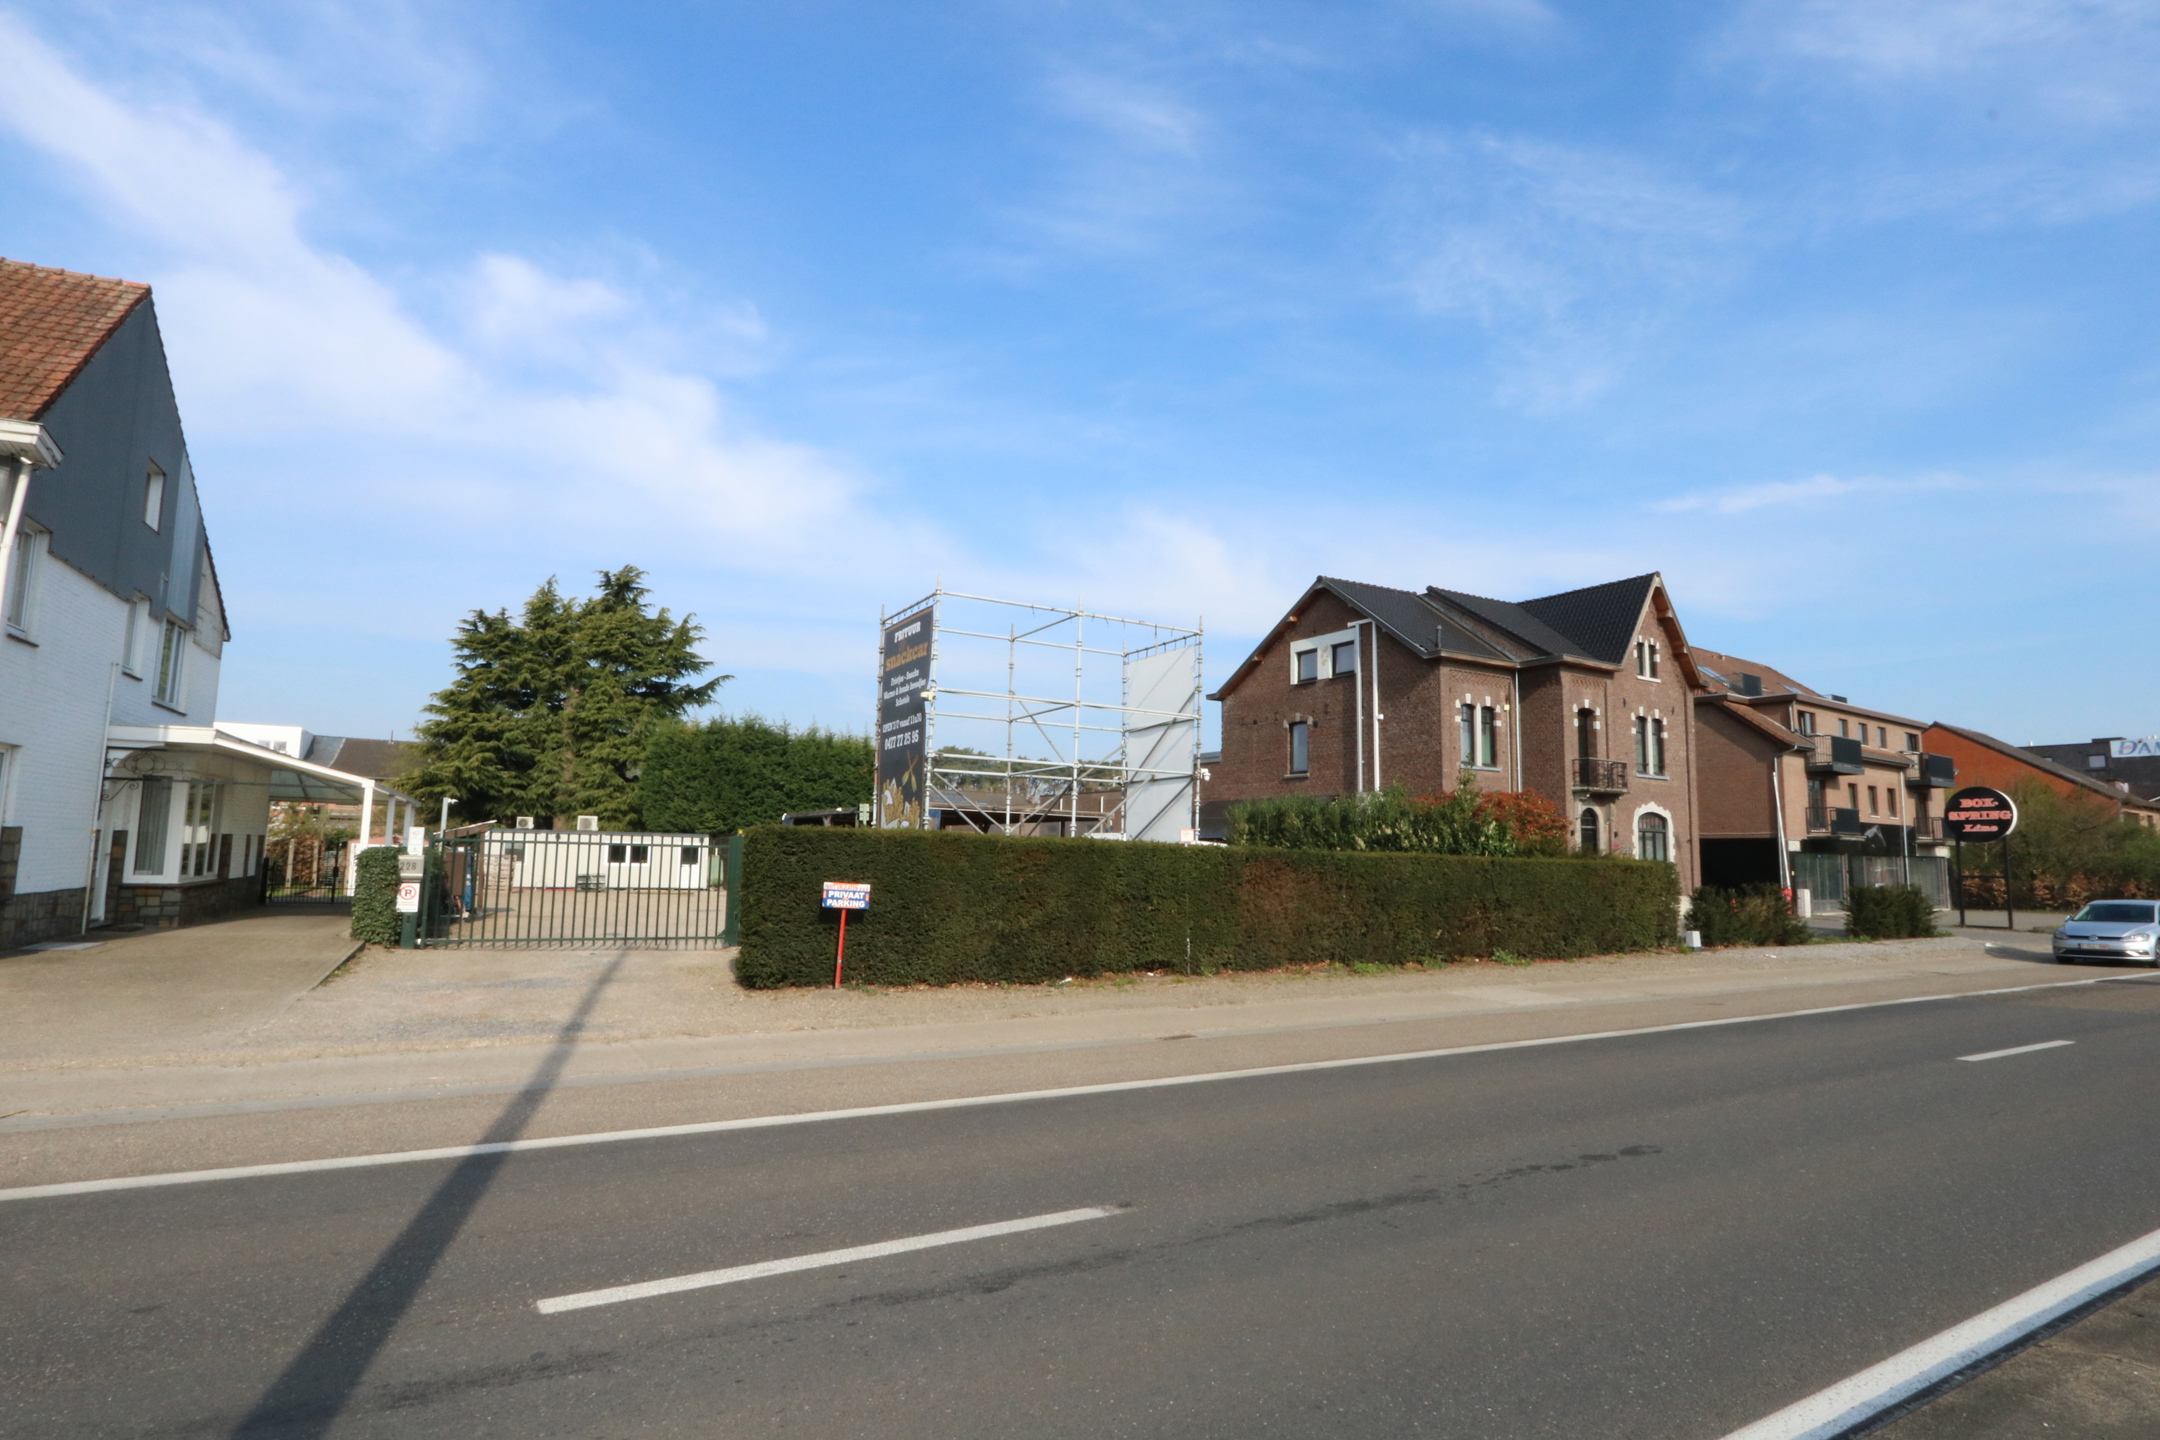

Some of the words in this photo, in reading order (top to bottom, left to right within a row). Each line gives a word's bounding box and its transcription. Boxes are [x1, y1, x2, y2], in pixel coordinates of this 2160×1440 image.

[894, 621, 921, 643] FRITUUR
[886, 641, 929, 672] snackcar
[882, 723, 893, 733] OPEN
[885, 735, 897, 751] 0477
[897, 733, 904, 748] 77
[904, 731, 911, 746] 25
[911, 729, 919, 744] 95
[1959, 798, 1999, 808] BOX-
[1948, 810, 2012, 821] SPRING
[400, 862, 417, 871] 228
[828, 890, 865, 899] PRIVAAT
[826, 899, 866, 908] PARKING
